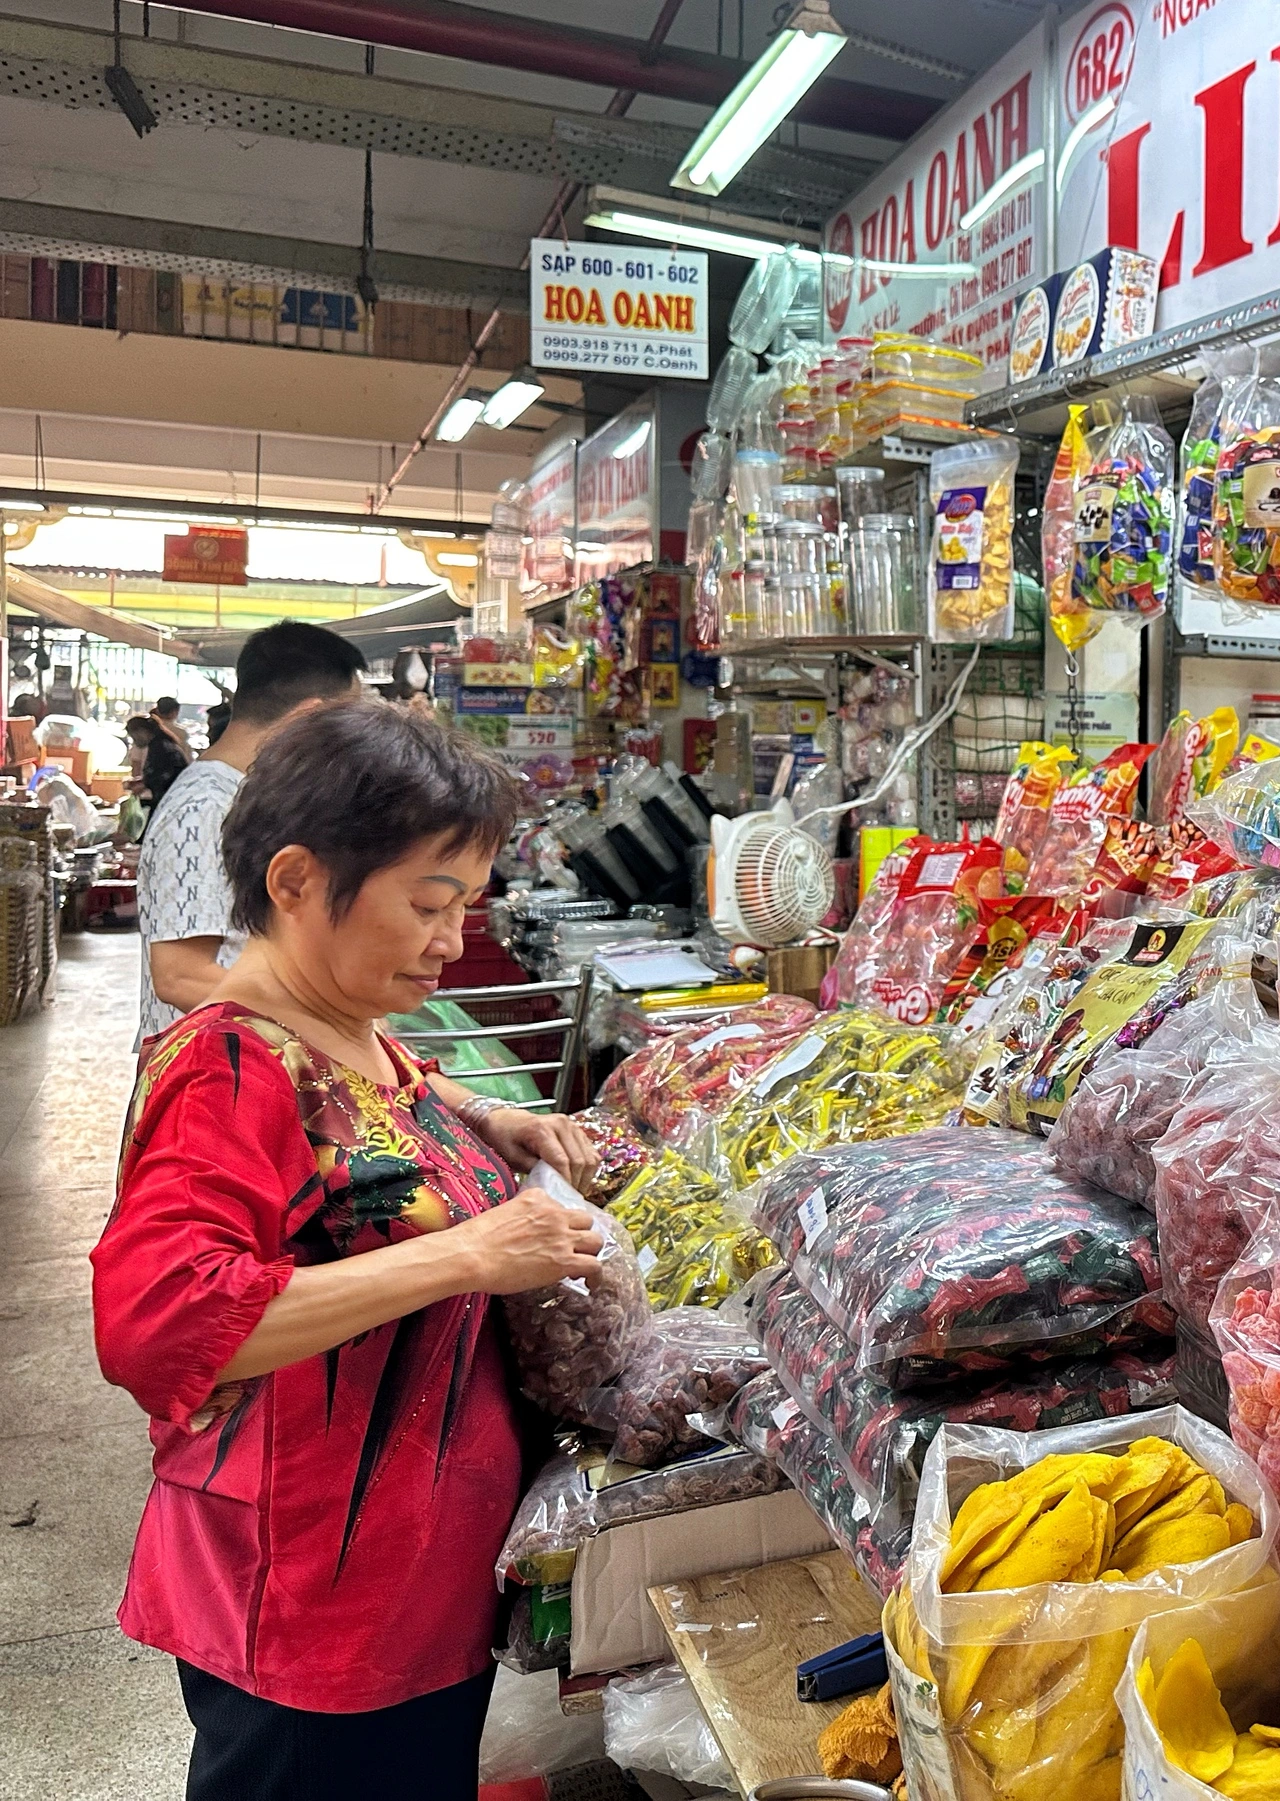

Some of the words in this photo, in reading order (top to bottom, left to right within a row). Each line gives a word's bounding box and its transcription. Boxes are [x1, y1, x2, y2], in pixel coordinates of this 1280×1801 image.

[1076, 21, 1124, 113] 682
[542, 254, 576, 276] SẠP
[582, 258, 612, 277] 600
[625, 261, 654, 280] 601
[668, 265, 699, 284] 602
[544, 284, 606, 325] HOA
[613, 290, 696, 333] OANH
[613, 341, 638, 353] 711
